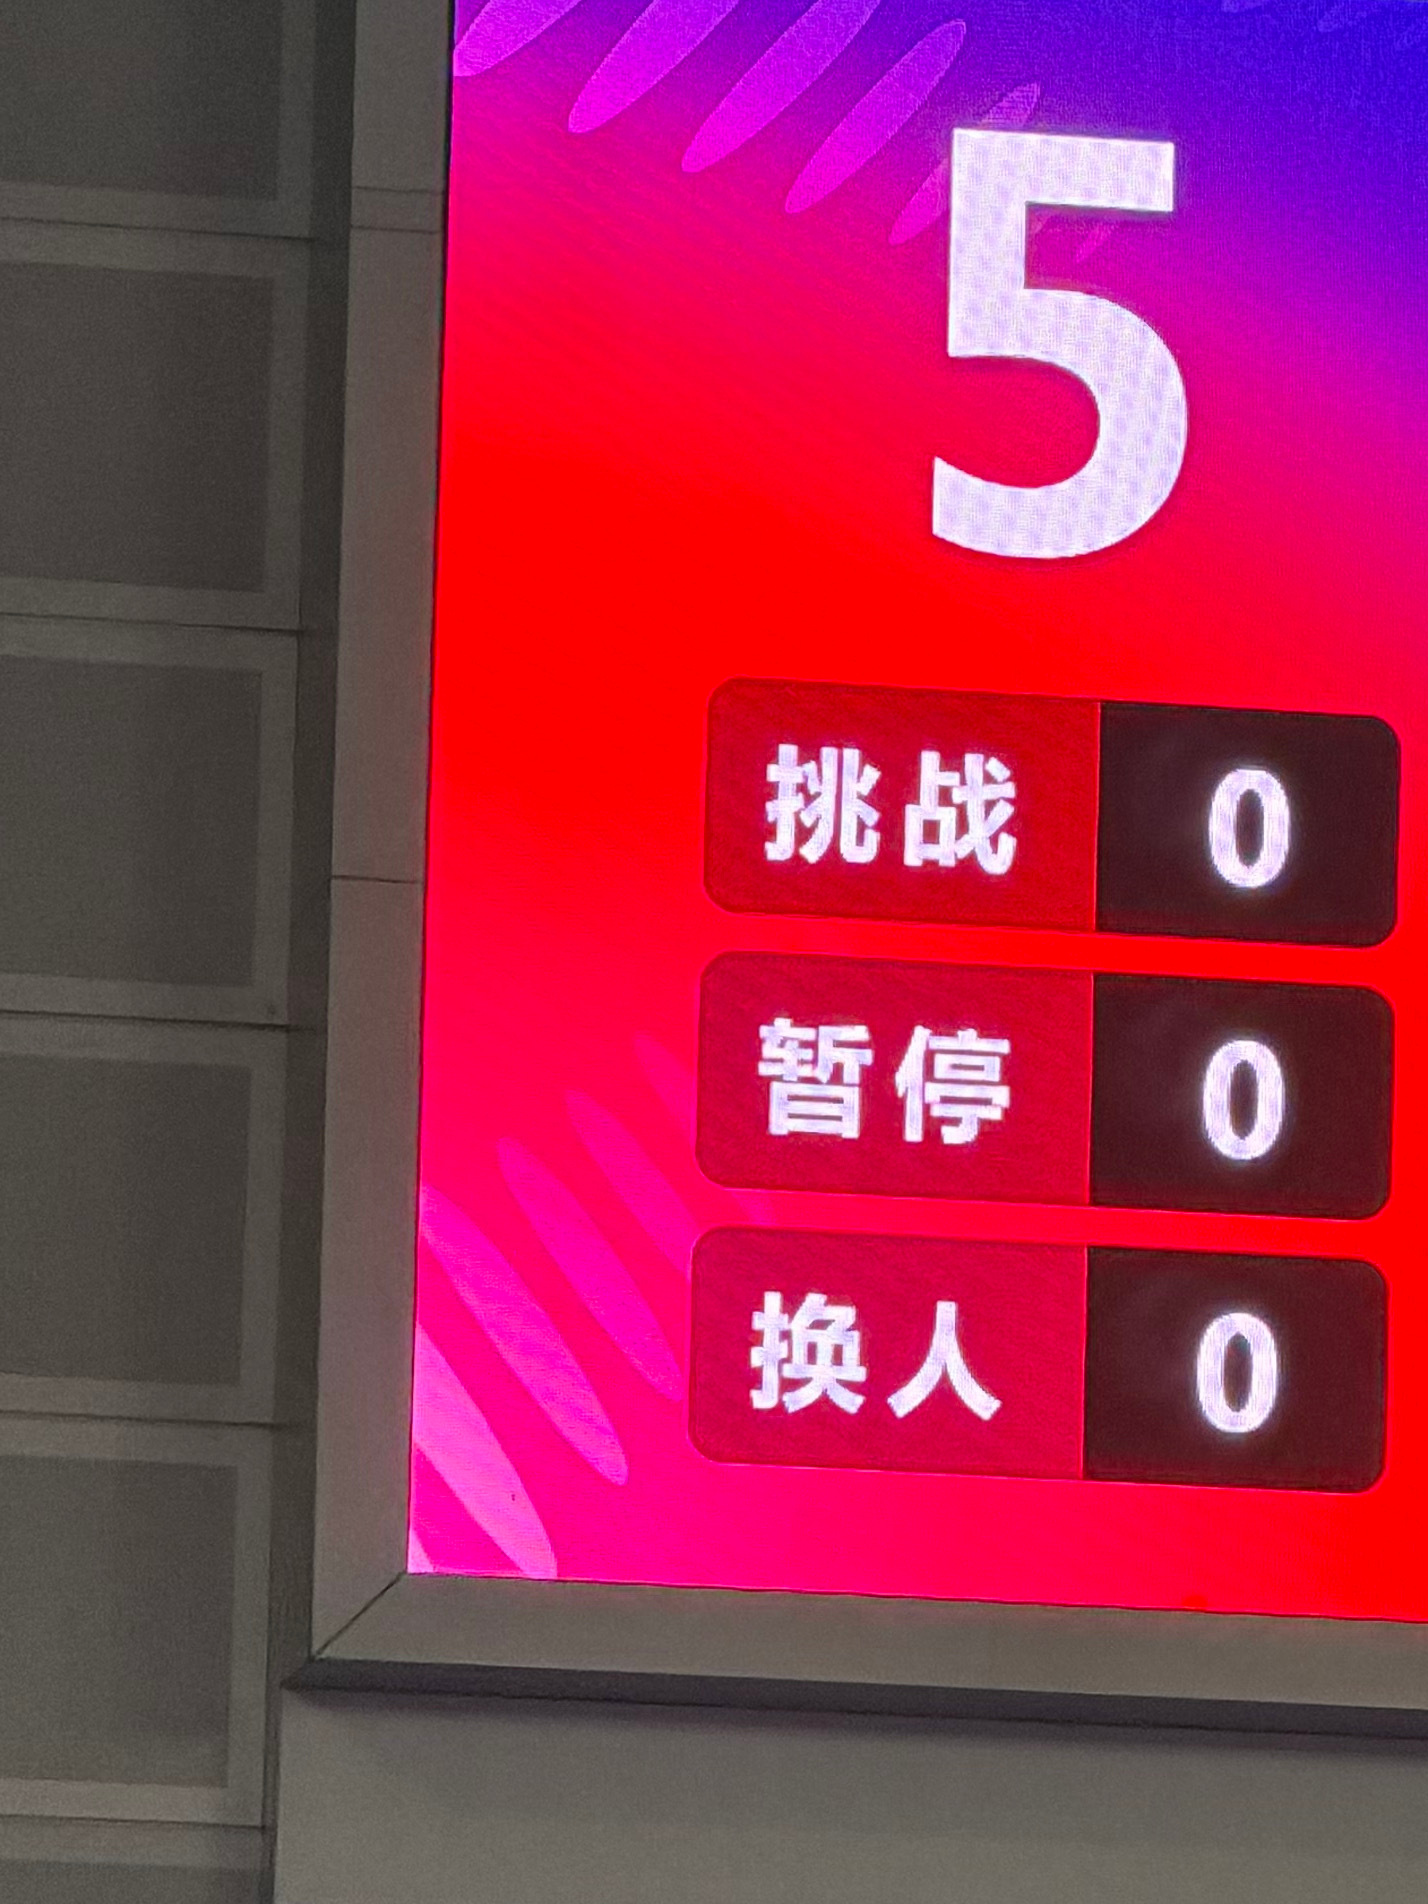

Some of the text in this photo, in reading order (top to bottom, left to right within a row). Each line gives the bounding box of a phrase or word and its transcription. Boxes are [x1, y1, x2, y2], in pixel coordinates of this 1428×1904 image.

[932, 127, 1188, 559] 5
[764, 743, 1017, 875] 挑战
[1207, 765, 1292, 889] 0
[757, 1017, 1011, 1146] 暂停
[1201, 1038, 1286, 1161] 0
[749, 1291, 1002, 1422] 换人
[1195, 1311, 1281, 1434] 0
